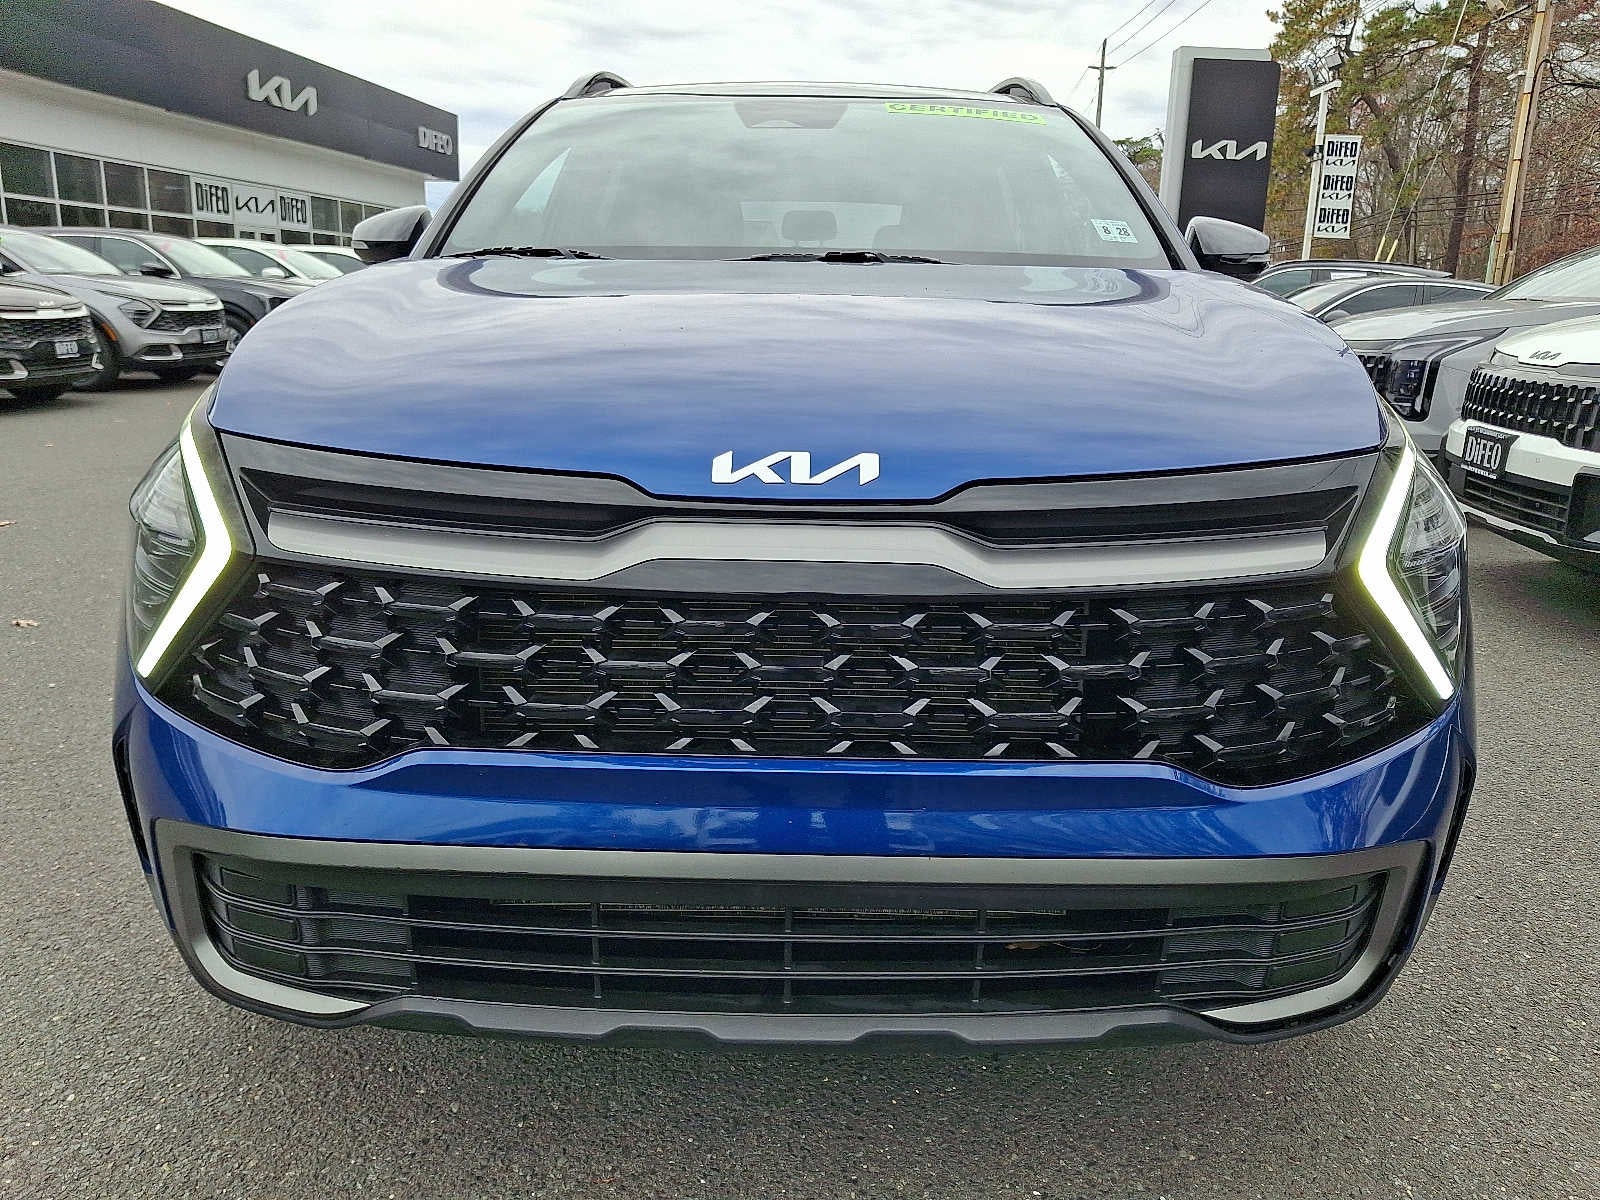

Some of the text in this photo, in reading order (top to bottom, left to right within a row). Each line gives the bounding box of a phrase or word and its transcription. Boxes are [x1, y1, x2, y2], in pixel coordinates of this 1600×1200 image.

[247, 69, 318, 117] KIA
[888, 103, 1038, 121] CERTIFIED
[1191, 139, 1267, 161] KIA
[1102, 225, 1131, 237] 8 28
[711, 450, 880, 486] KIA
